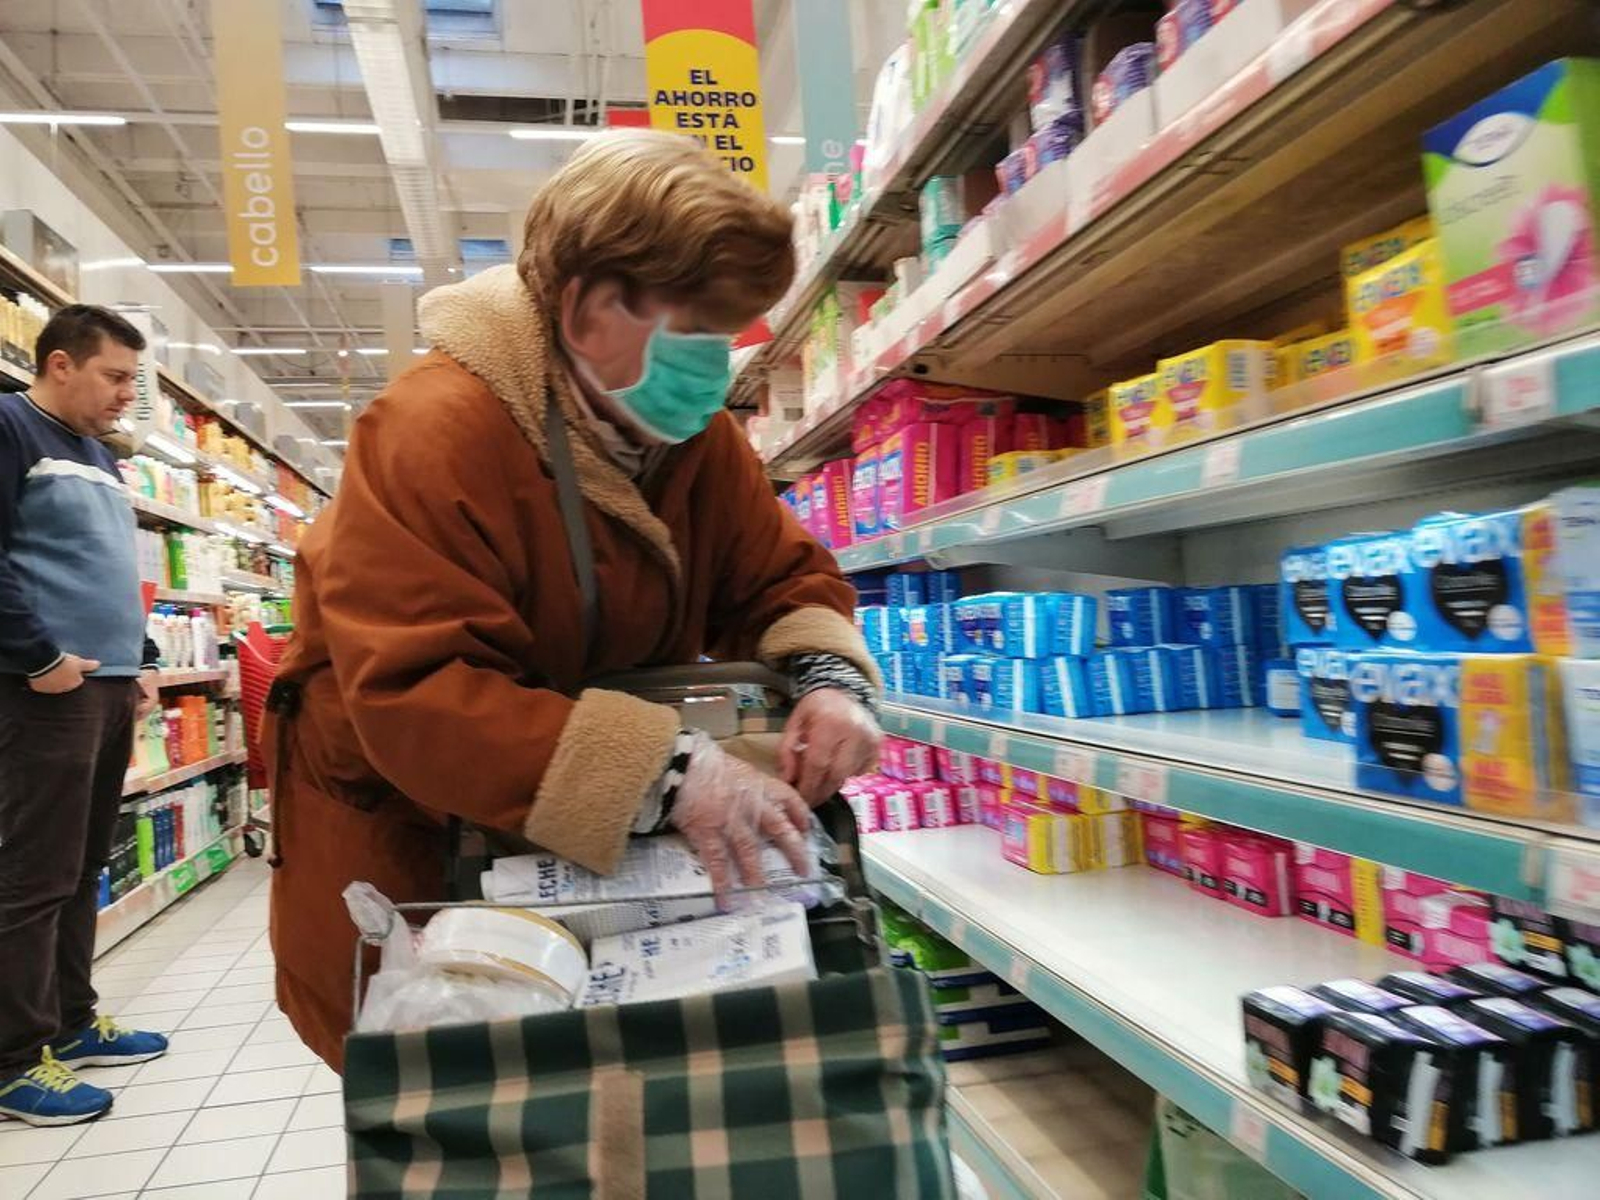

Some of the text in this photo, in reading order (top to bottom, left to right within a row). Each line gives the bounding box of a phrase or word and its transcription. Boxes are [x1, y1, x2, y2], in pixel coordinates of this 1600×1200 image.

[690, 69, 717, 85] EL
[654, 89, 756, 107] AHORRO
[677, 108, 740, 128] ESTÁ
[715, 134, 743, 150] EL
[232, 126, 280, 267] cabello
[536, 859, 559, 900] ECHE
